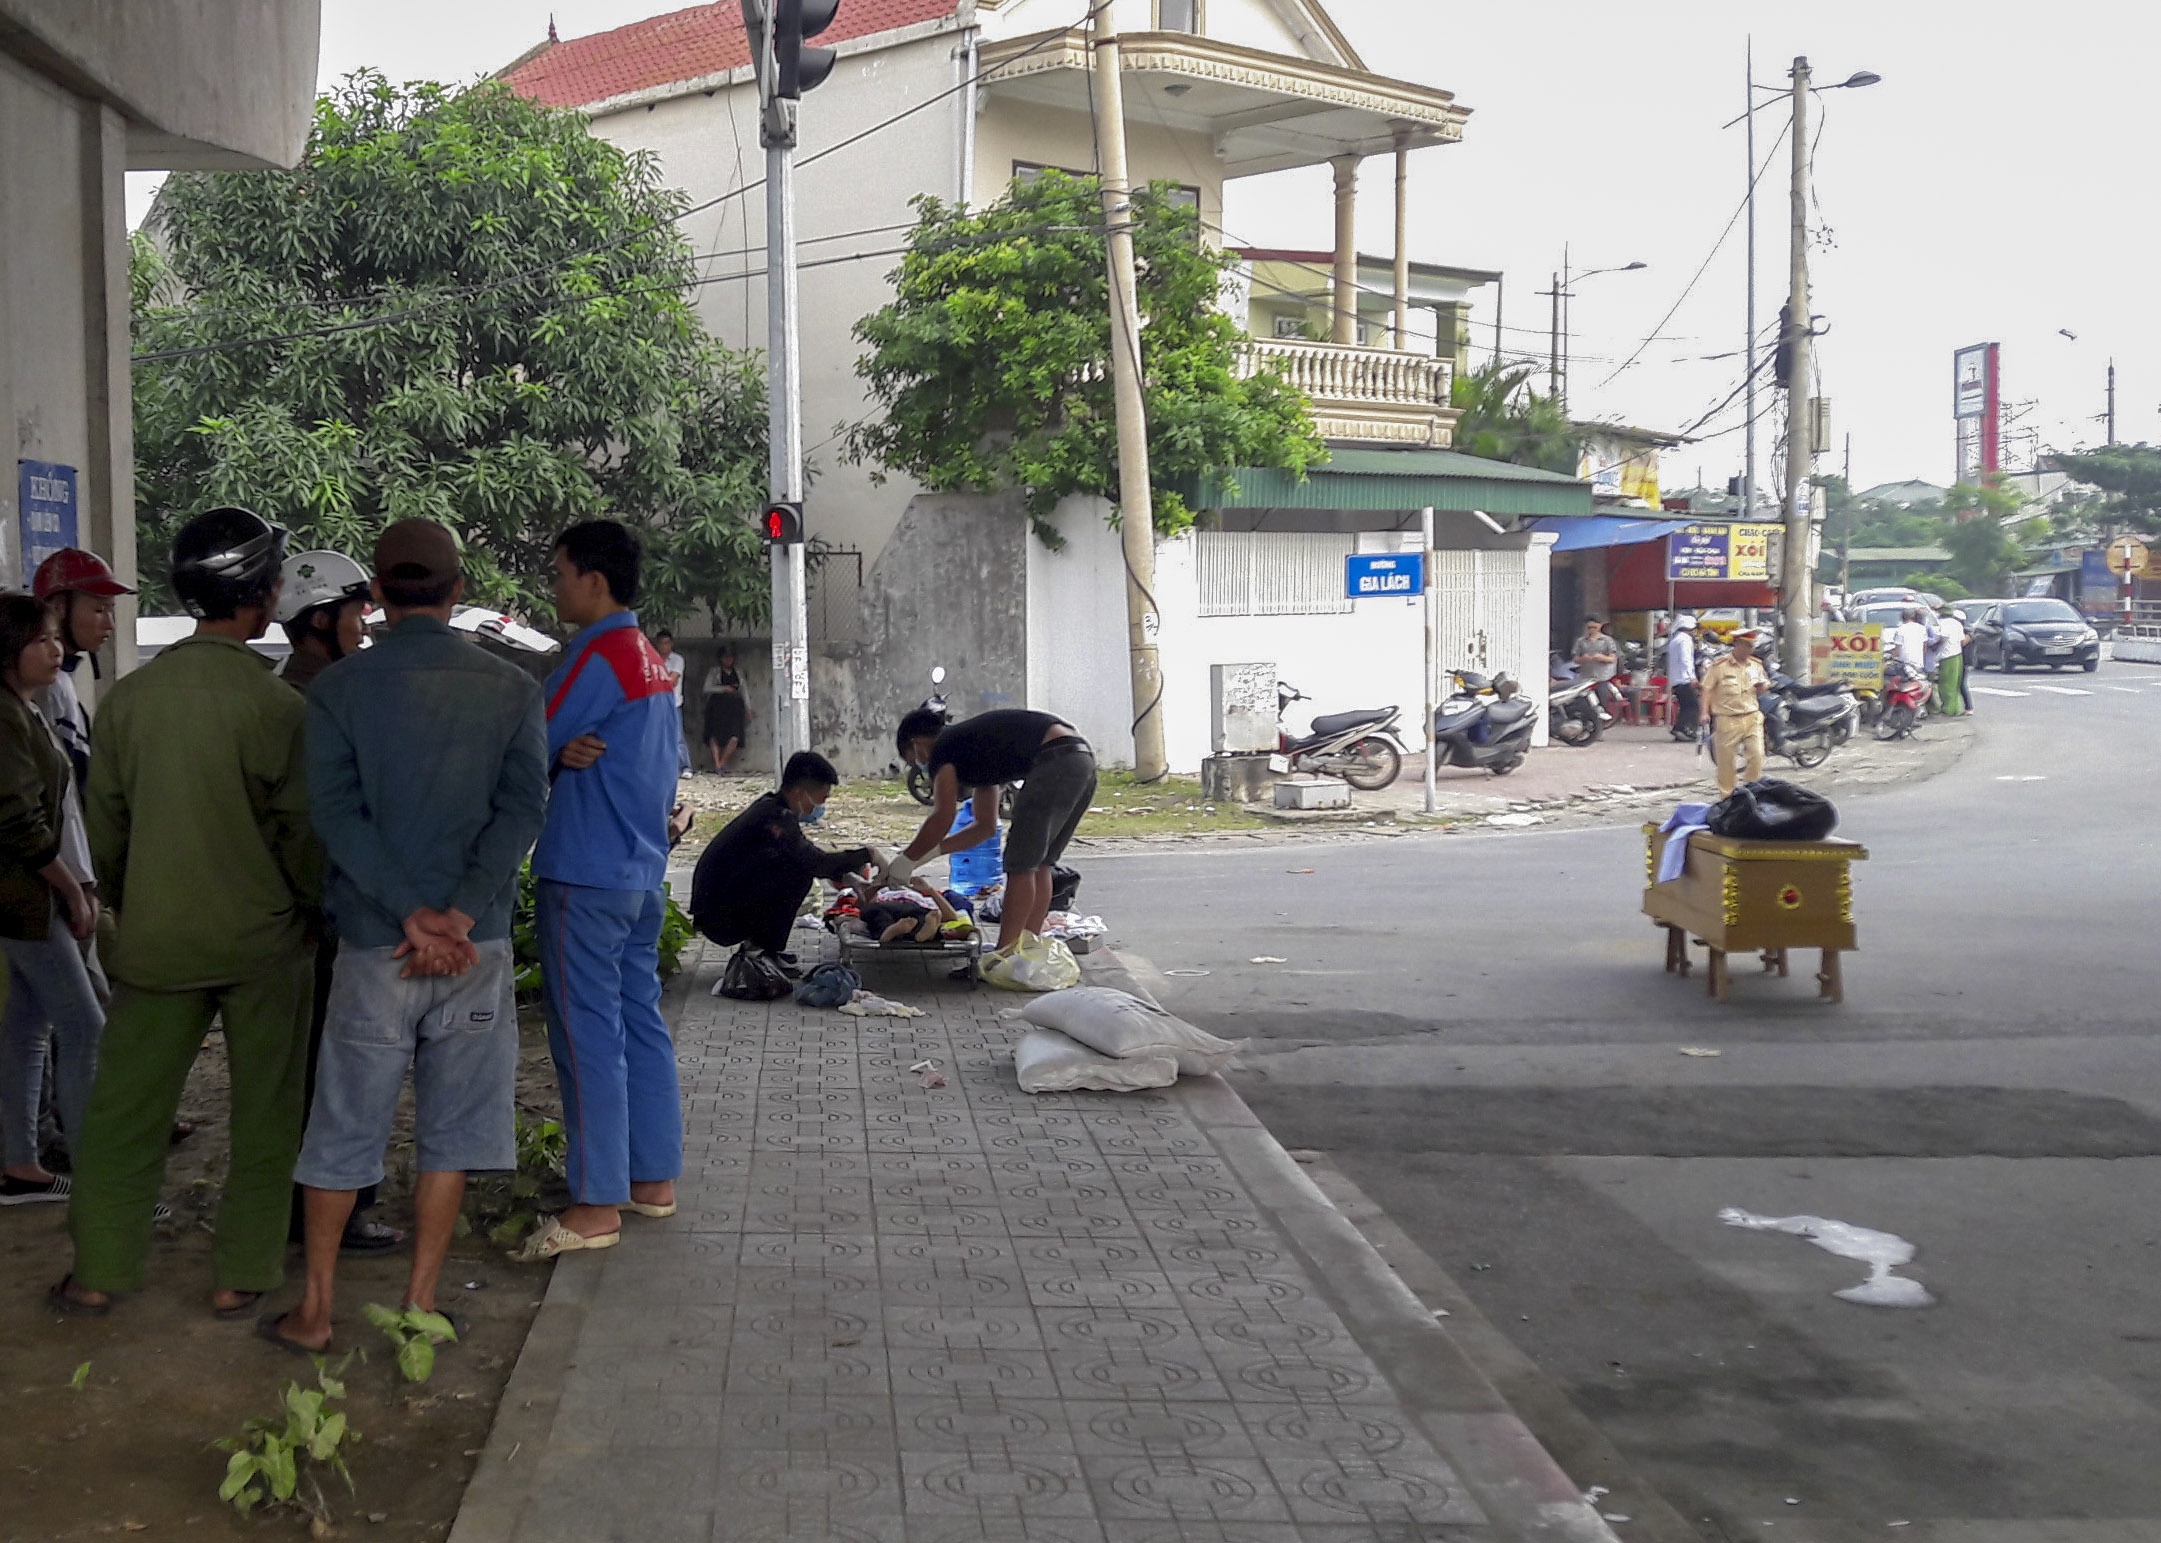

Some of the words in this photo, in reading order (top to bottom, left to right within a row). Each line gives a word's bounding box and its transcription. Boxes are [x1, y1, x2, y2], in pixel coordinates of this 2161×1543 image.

[1360, 576, 1379, 592] GIA
[1380, 572, 1411, 591] LÁCH
[1831, 632, 1880, 652] XÔI
